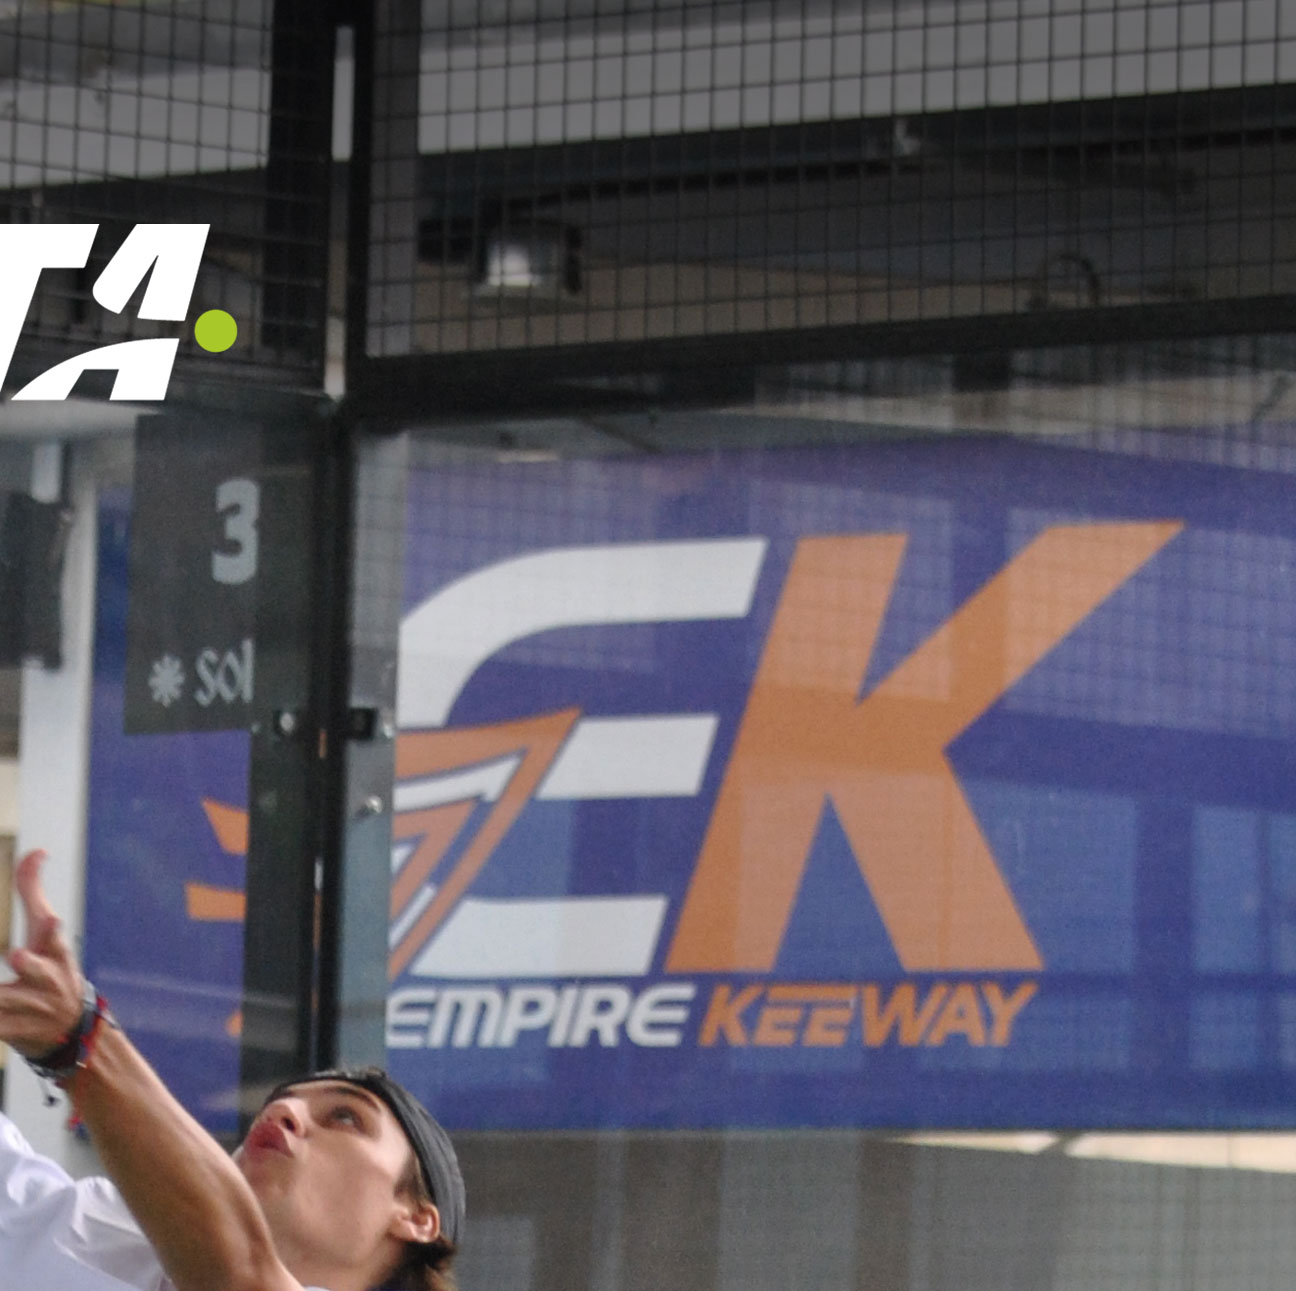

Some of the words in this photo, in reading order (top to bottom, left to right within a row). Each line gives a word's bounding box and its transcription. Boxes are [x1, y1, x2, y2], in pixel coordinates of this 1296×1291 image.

[212, 478, 260, 585] 3
[386, 983, 695, 1048] EMPIRE
[699, 983, 1038, 1048] KEEWAY
